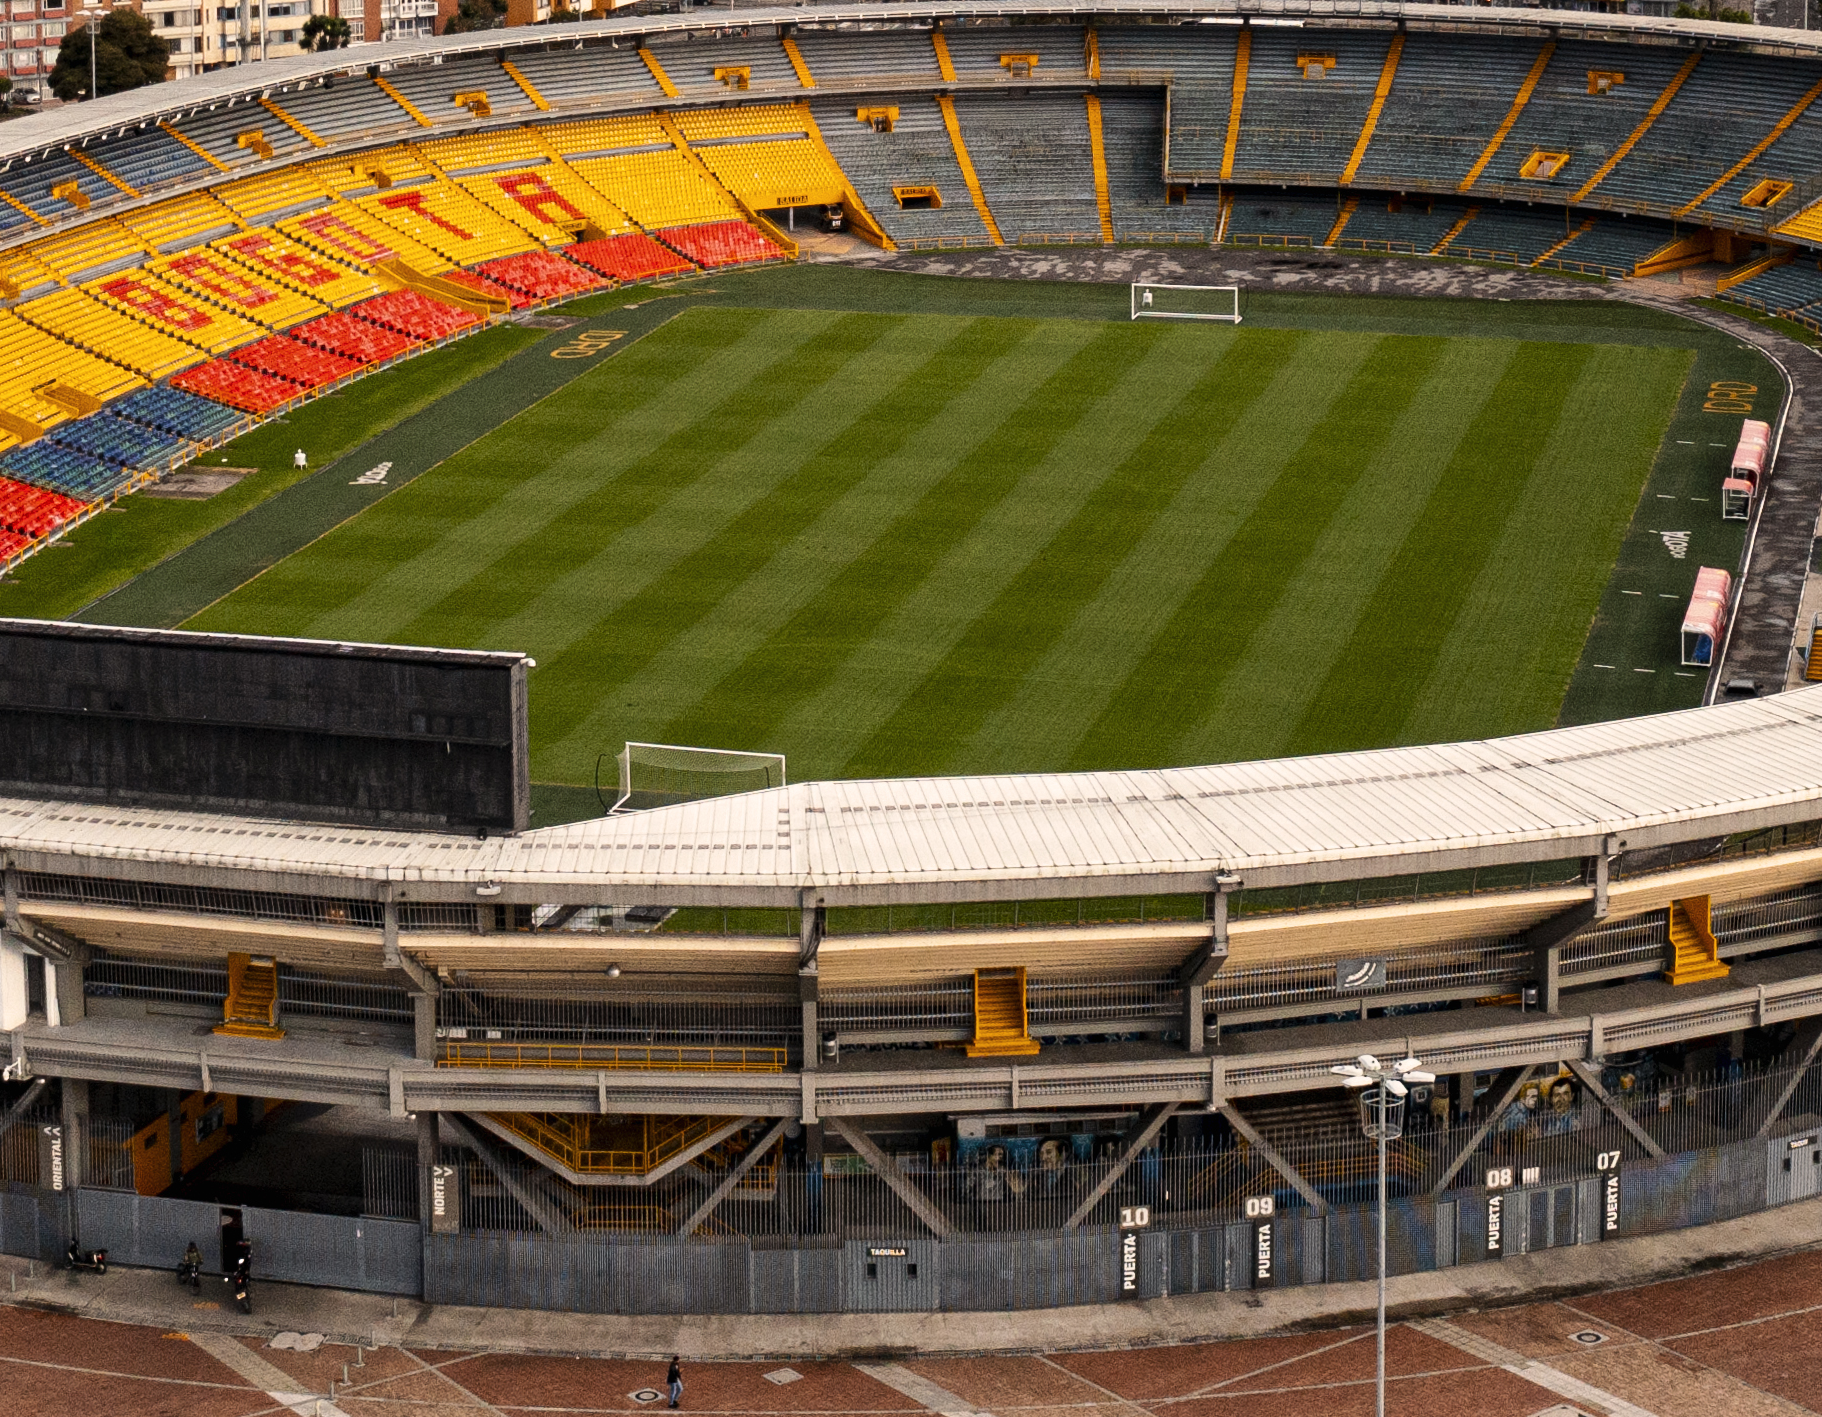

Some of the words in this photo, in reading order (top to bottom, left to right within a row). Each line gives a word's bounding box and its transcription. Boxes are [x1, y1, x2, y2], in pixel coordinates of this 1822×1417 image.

[550, 329, 629, 360] IDRD
[1702, 381, 1758, 414] IDRD
[52, 1138, 63, 1190] ORIENTAL
[1487, 1168, 1512, 1187] 08
[1597, 1150, 1621, 1170] 07
[433, 1178, 445, 1215] NORTE
[1246, 1197, 1273, 1216] 09
[1606, 1176, 1619, 1230] PUERTA
[1122, 1207, 1149, 1227] 10
[1488, 1195, 1500, 1250] PUERTA
[1124, 1234, 1136, 1290] PUERTA
[1258, 1223, 1271, 1279] PUERTA
